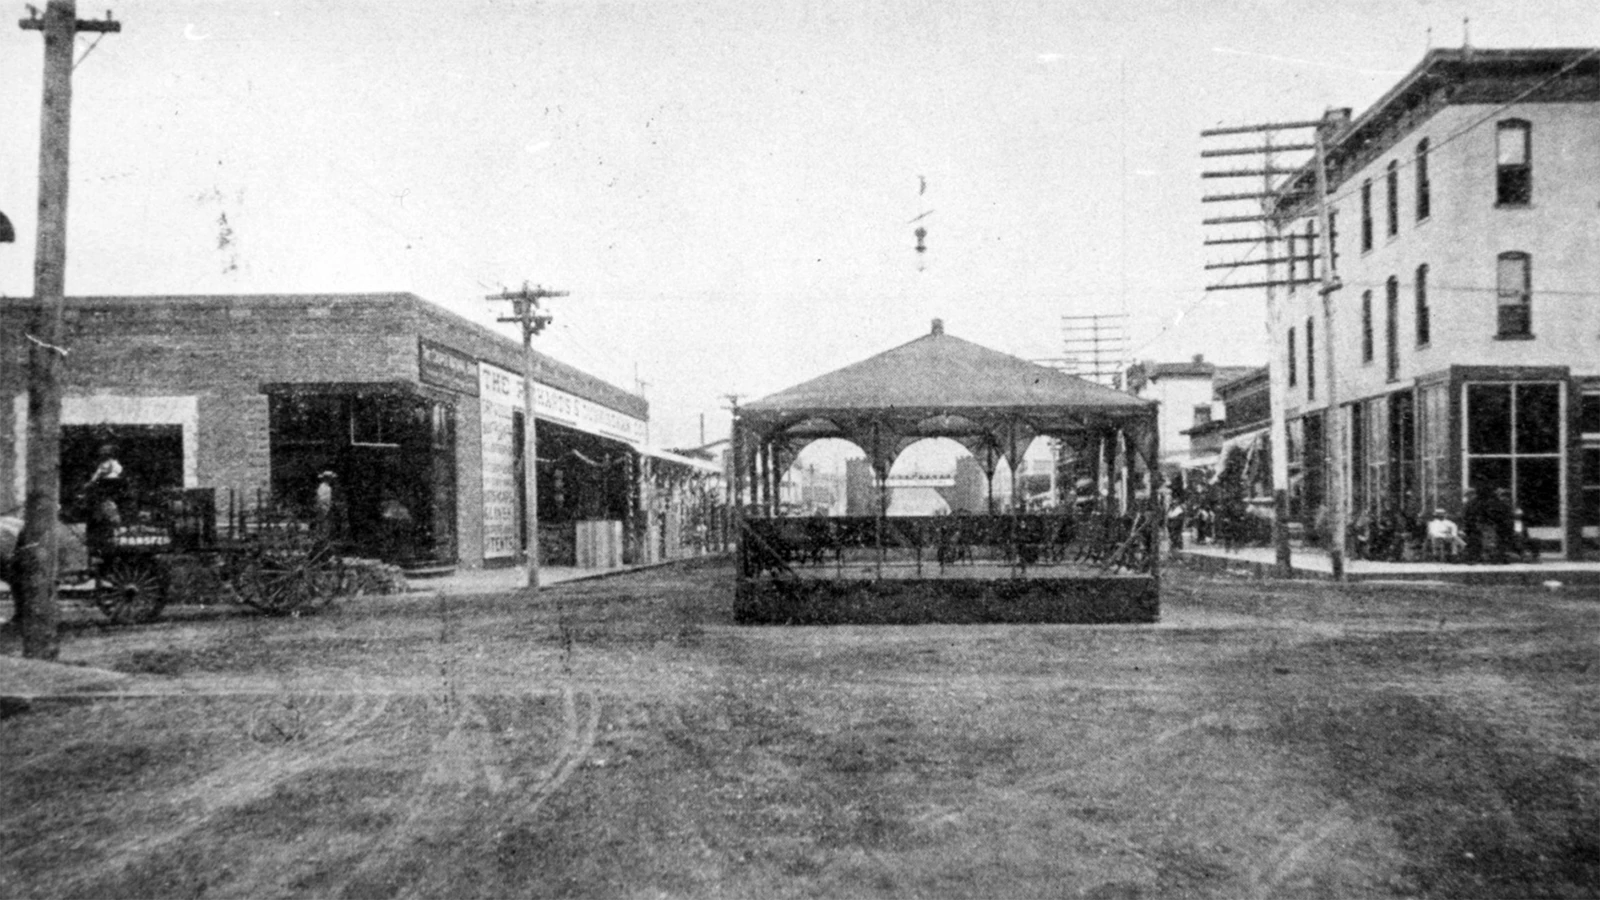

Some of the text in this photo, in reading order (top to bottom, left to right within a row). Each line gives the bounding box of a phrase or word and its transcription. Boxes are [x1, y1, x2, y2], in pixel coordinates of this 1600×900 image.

[482, 369, 510, 396] THE
[516, 381, 571, 416] RHARDS
[113, 535, 171, 546] TRANSFER
